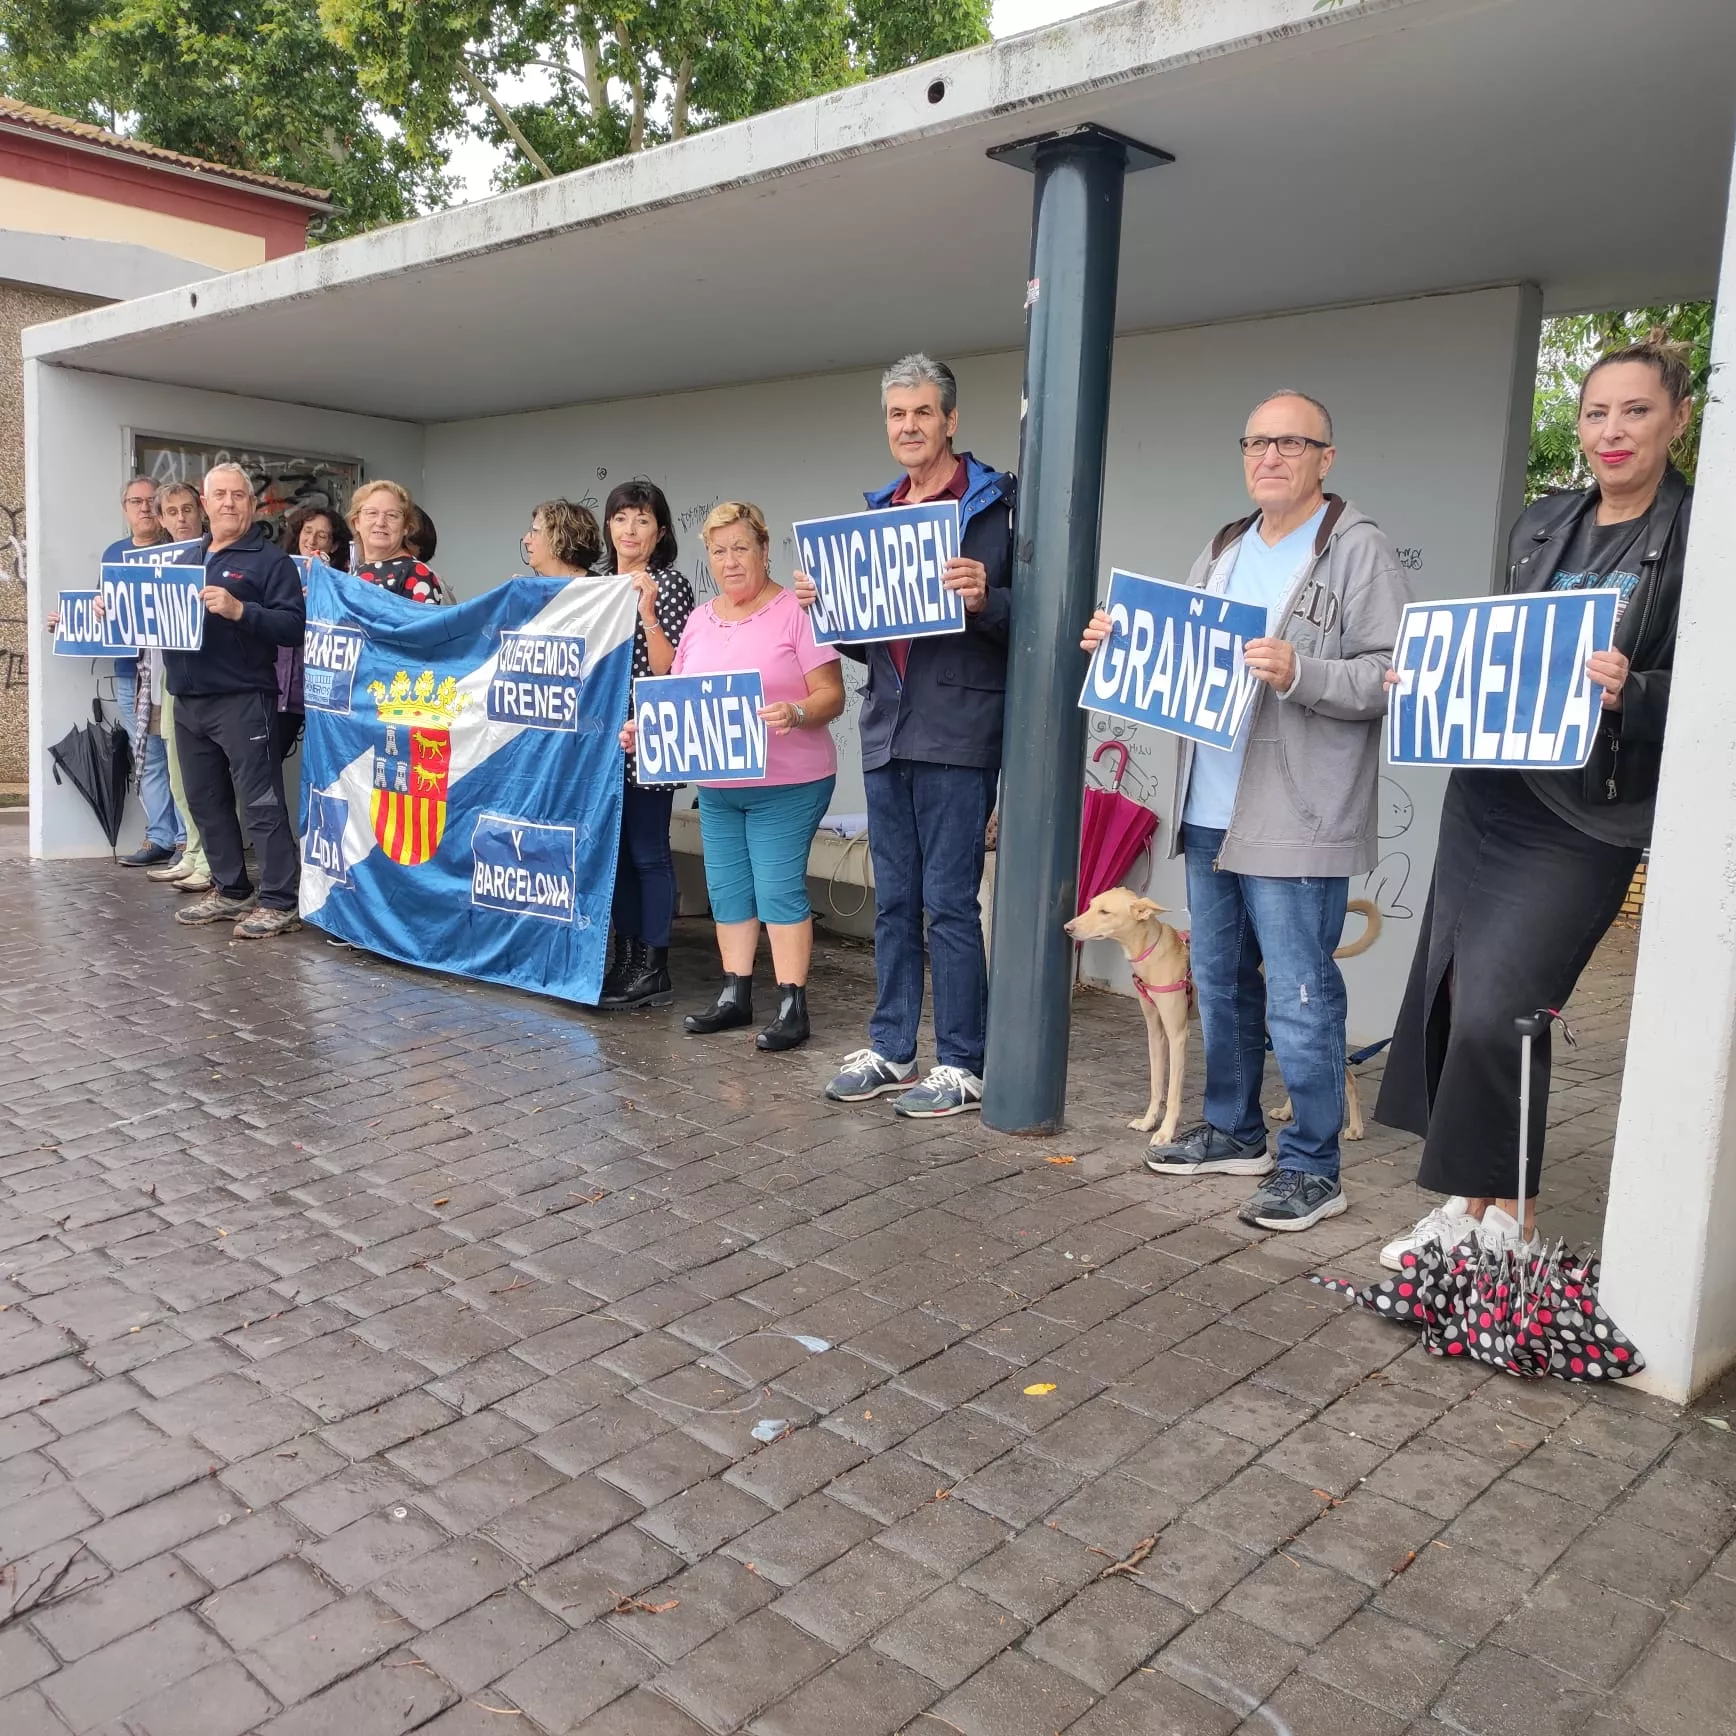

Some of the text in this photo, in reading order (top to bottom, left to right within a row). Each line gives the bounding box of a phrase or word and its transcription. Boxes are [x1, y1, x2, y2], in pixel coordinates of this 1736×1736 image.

[803, 519, 956, 634] SANGARREN
[499, 639, 580, 677] QUEREMOS
[1393, 600, 1595, 761] FRAELLA
[493, 679, 576, 721] TRENES
[638, 675, 764, 775] GRAÑÉN
[511, 829, 524, 862] Y
[475, 861, 570, 908] BARCELONA
